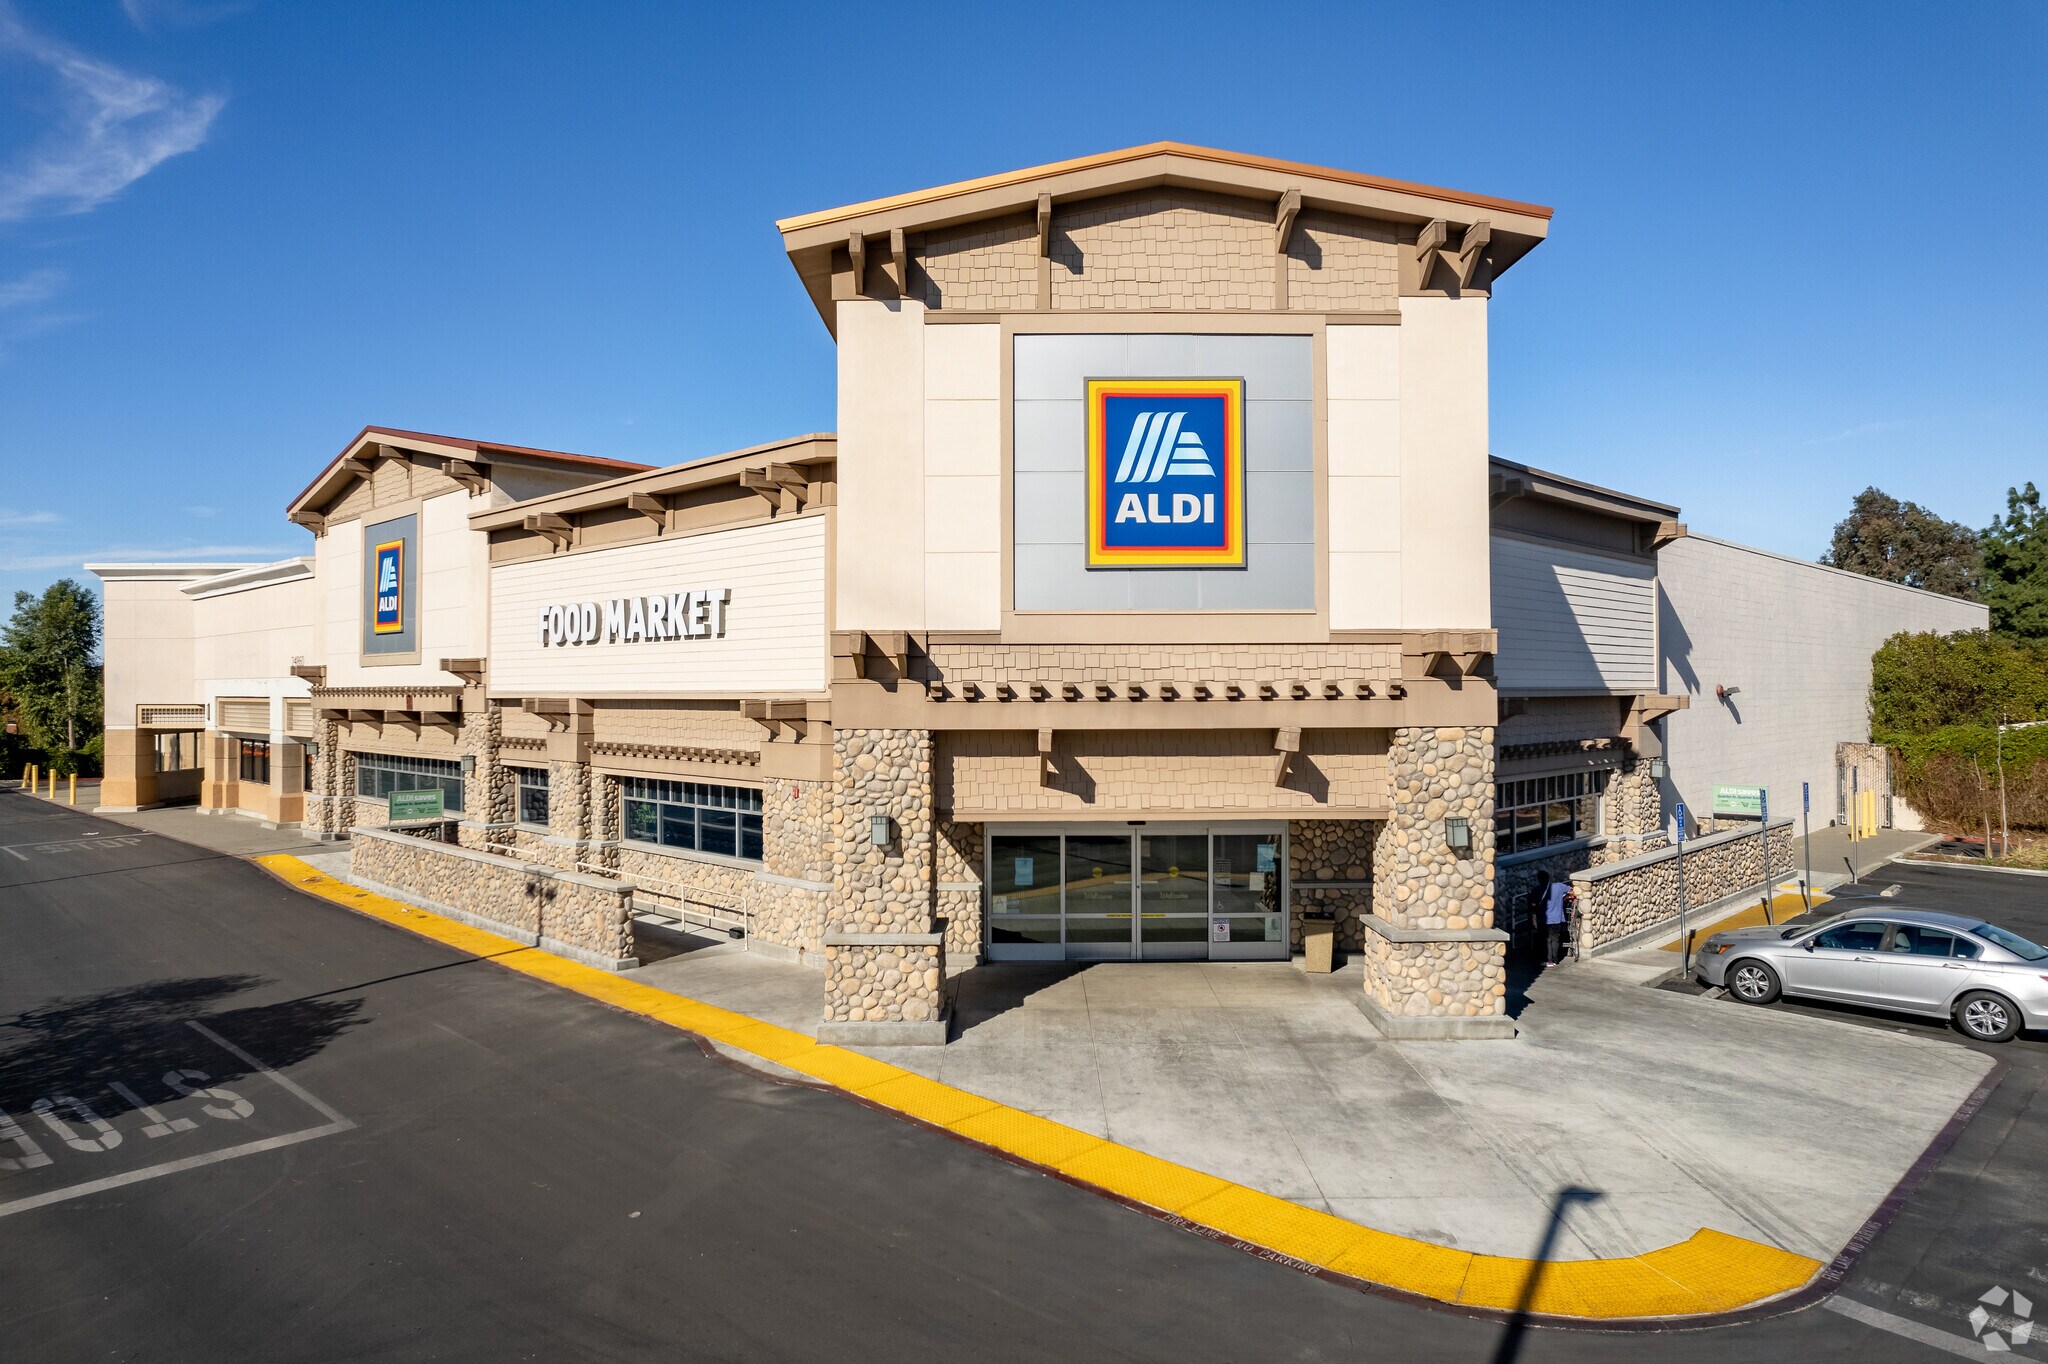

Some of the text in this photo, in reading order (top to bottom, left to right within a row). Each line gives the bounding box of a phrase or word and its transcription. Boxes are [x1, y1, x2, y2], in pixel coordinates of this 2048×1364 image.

[1114, 493, 1215, 524] ALDI
[378, 595, 398, 612] ALDI
[537, 588, 731, 646] FOOD MARKET
[34, 837, 142, 854] STOP
[1163, 1213, 1320, 1275] FIRE LANE NO PARKING
